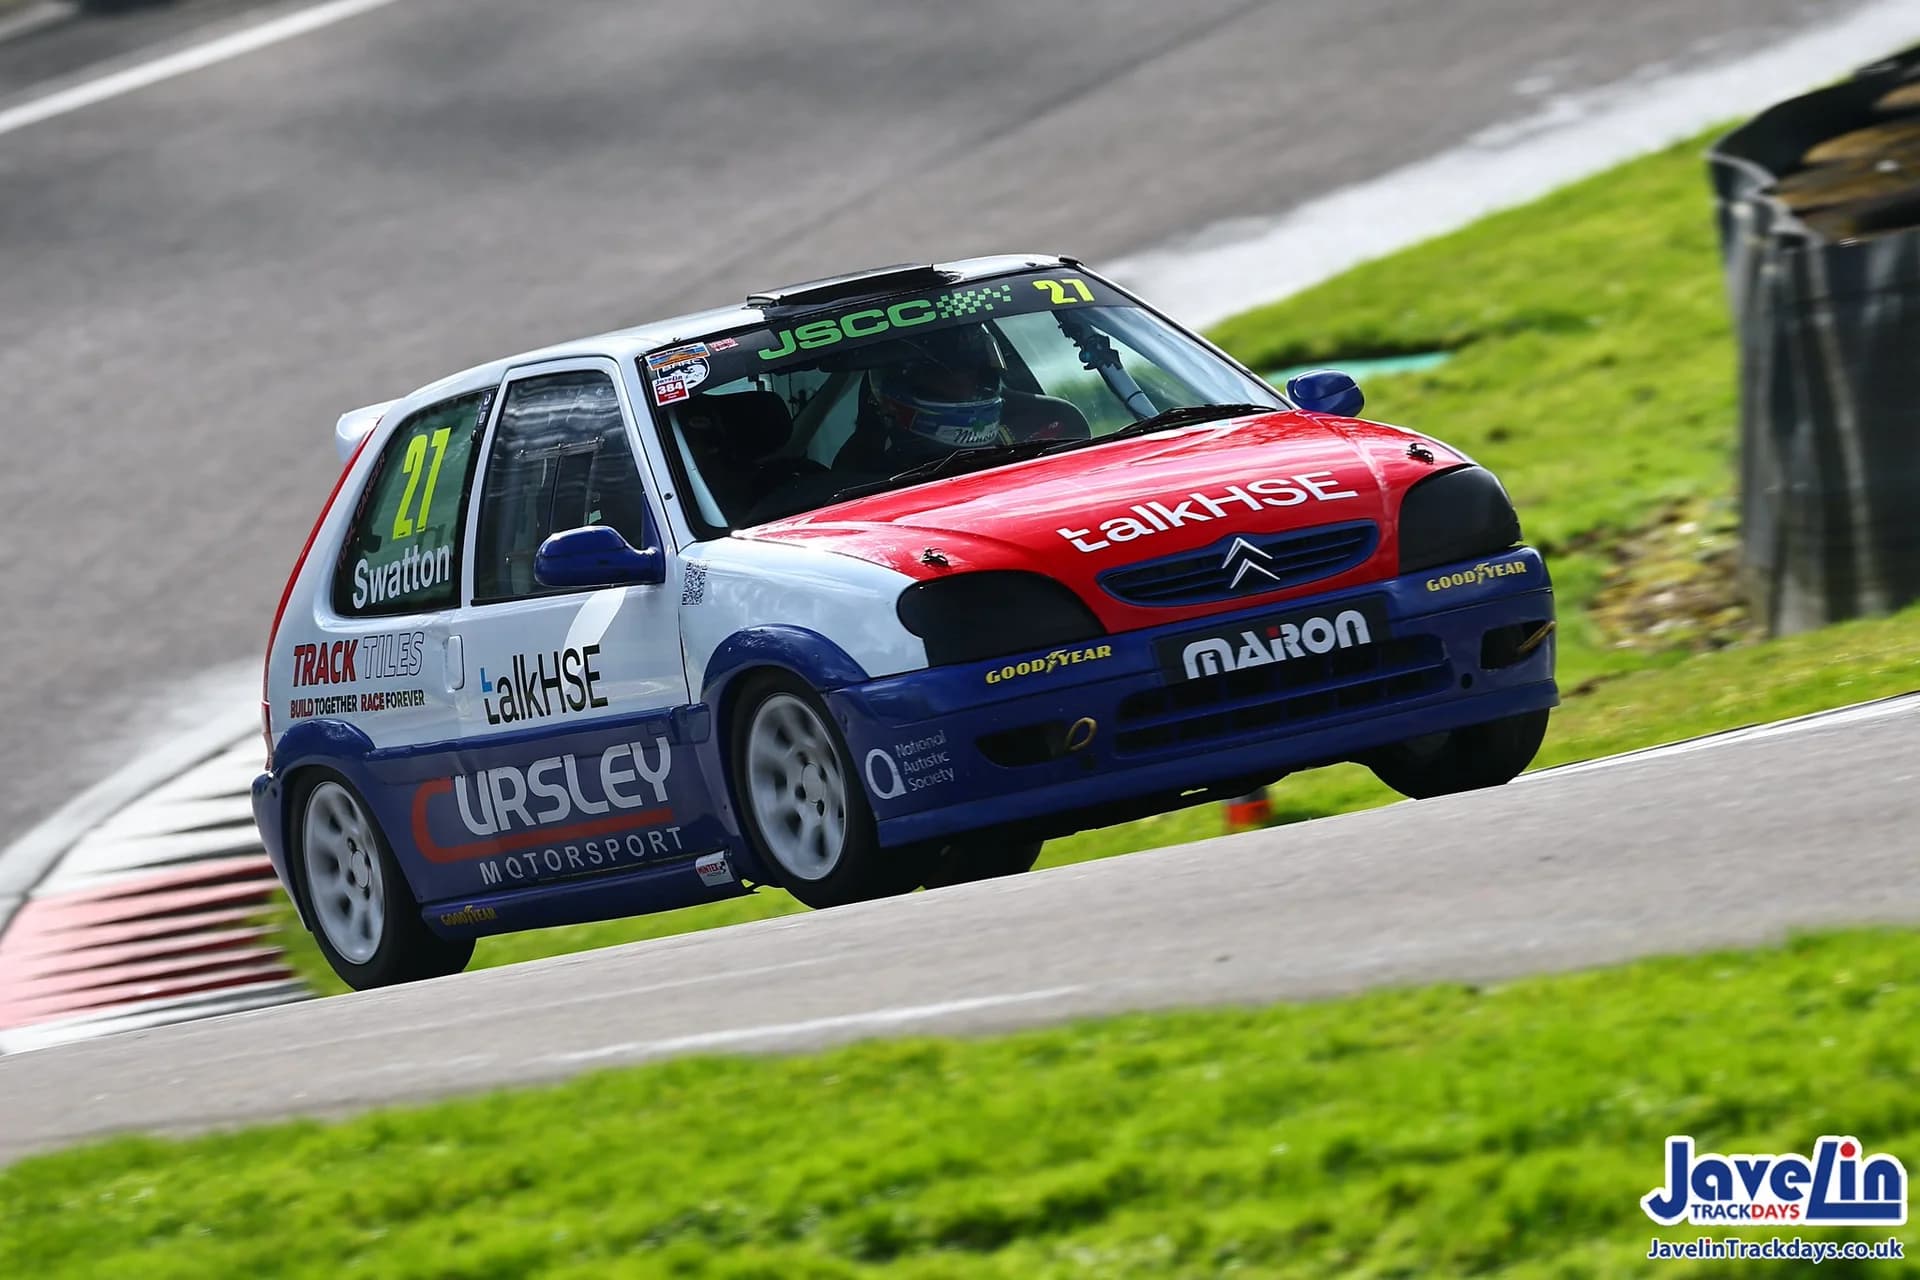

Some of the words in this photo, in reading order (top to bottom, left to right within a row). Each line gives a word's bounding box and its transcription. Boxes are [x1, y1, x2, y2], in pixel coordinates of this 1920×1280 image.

[1032, 278, 1096, 305] 27
[758, 299, 936, 361] JSCC
[657, 382, 683, 395] 384
[392, 427, 452, 540] 27
[1056, 471, 1359, 553] talkHSE
[352, 544, 451, 610] Swatton
[1426, 560, 1527, 592] GOODYEAR
[293, 639, 359, 687] TRACK
[363, 631, 425, 679] TILES
[986, 644, 1112, 685] GOODYEAR
[290, 698, 314, 718] BUILD
[314, 694, 358, 716] TOGETHER
[361, 692, 385, 711] RACE
[385, 689, 425, 709] FOREVER
[480, 645, 608, 725] talkHSE
[895, 729, 946, 758] National
[903, 751, 950, 775] Autistic
[411, 737, 674, 863] CURSLEY
[907, 767, 954, 792] Society
[479, 826, 684, 886] MOTORSPORT
[440, 904, 497, 926] GOODYEAR
